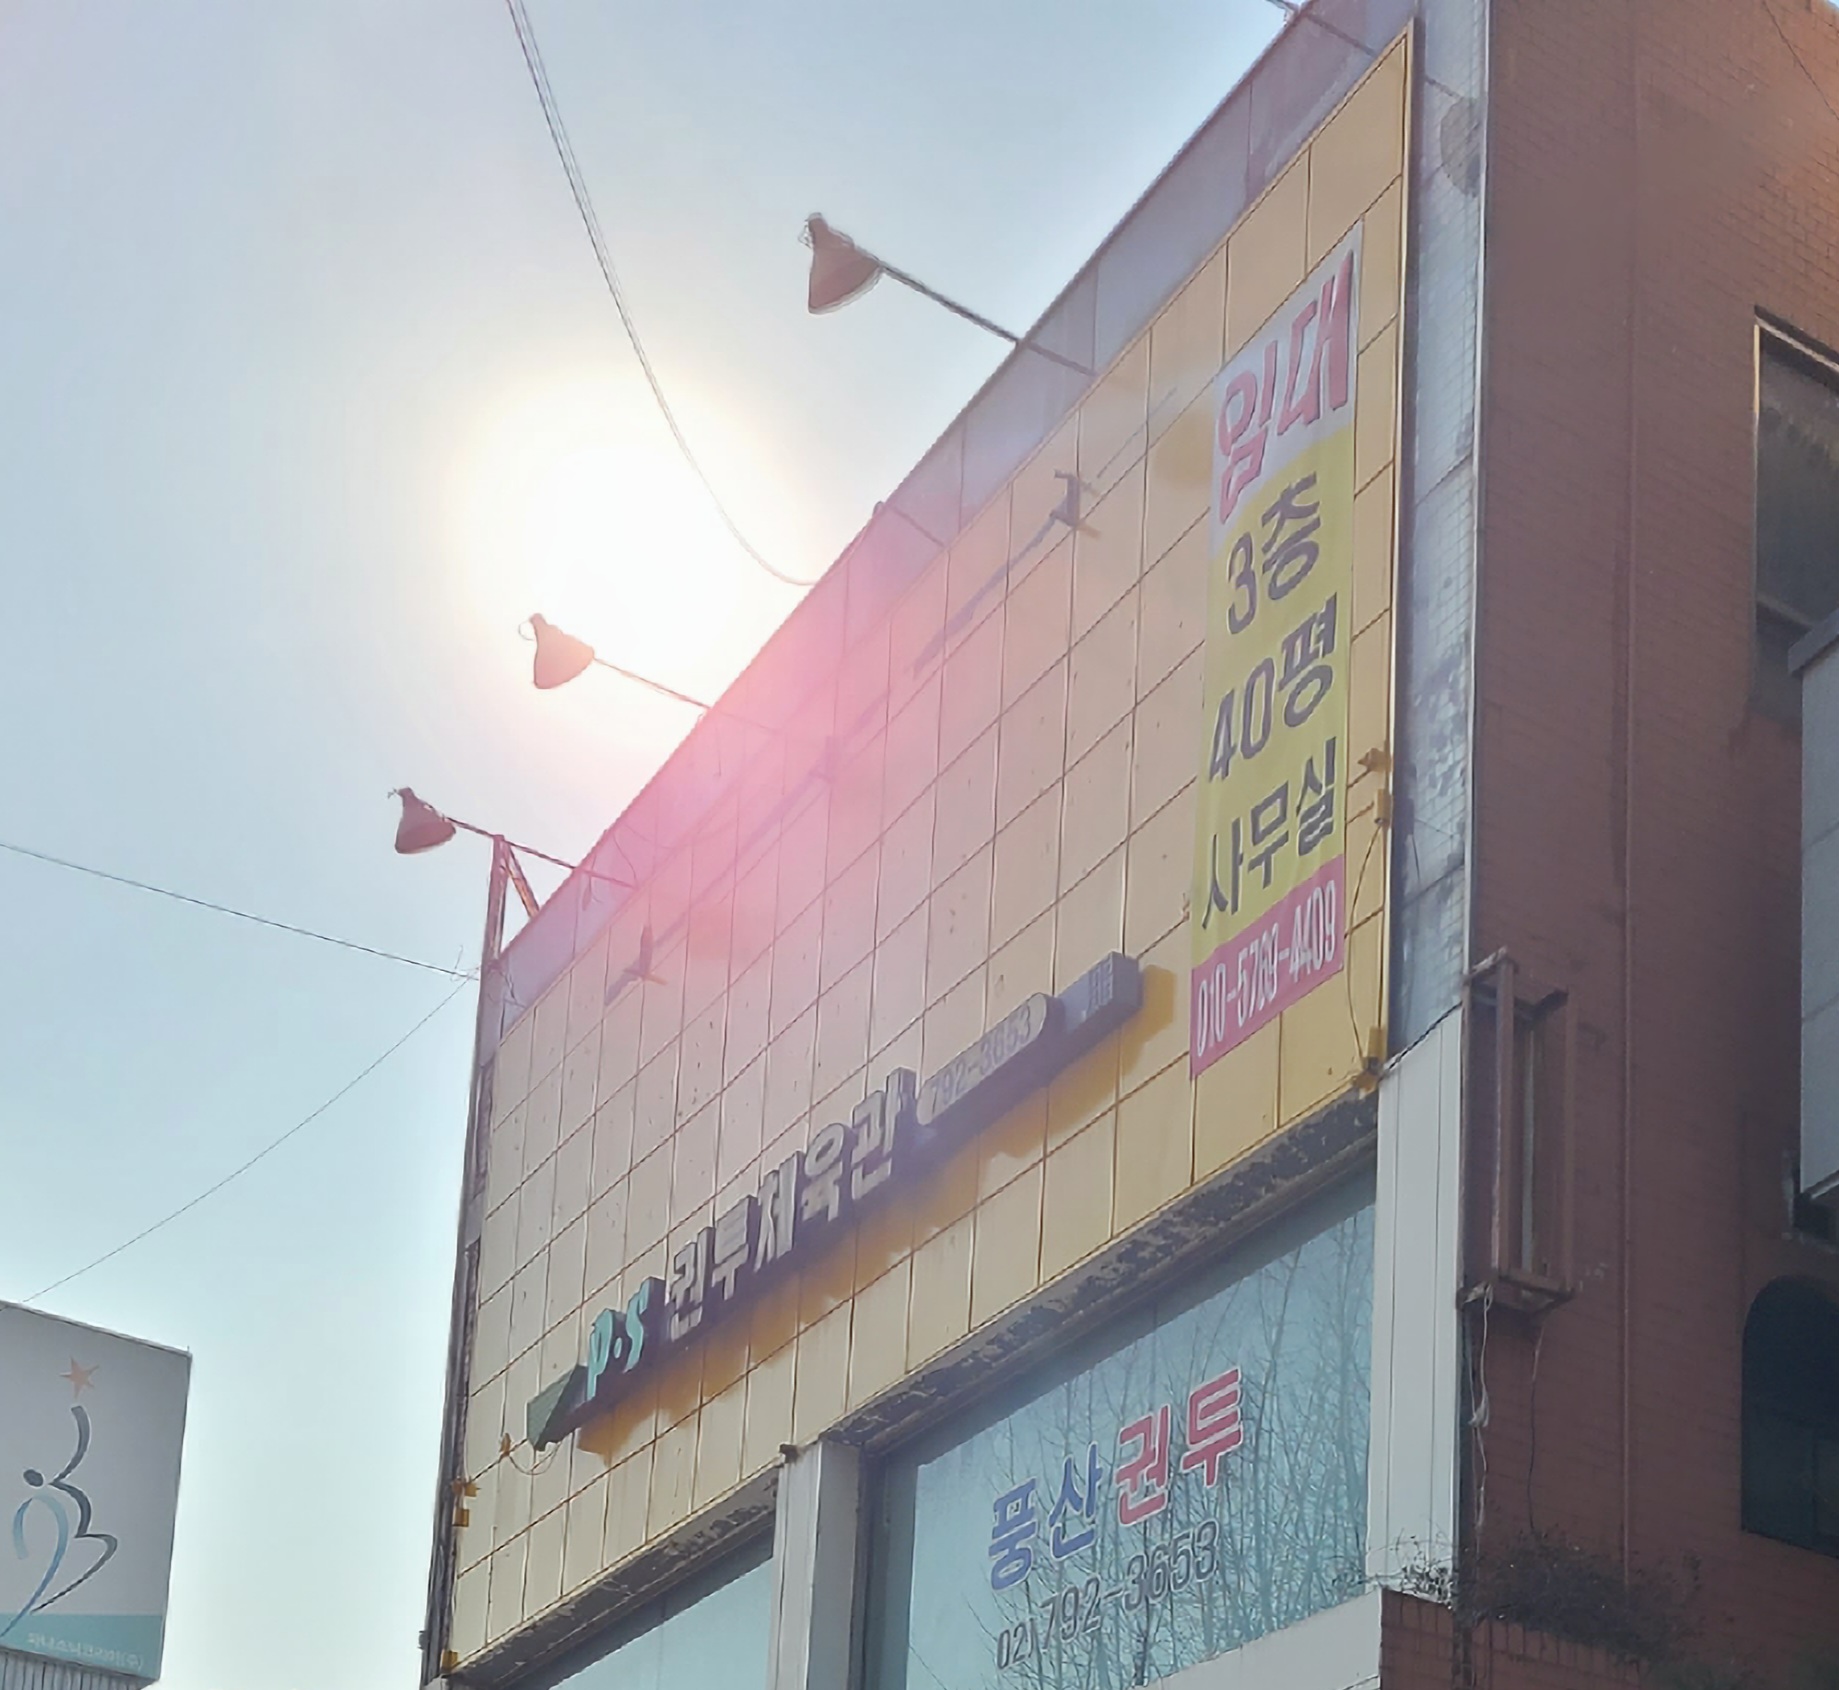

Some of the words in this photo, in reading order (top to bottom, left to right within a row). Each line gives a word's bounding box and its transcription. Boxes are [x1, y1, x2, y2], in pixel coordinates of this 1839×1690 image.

[1217, 250, 1353, 525] 임대
[1225, 472, 1321, 635] 3층
[1208, 593, 1338, 783] 40평
[1201, 737, 1337, 930] 사무실
[987, 1440, 1103, 1591] 풍산
[1114, 1367, 1244, 1526] 권투
